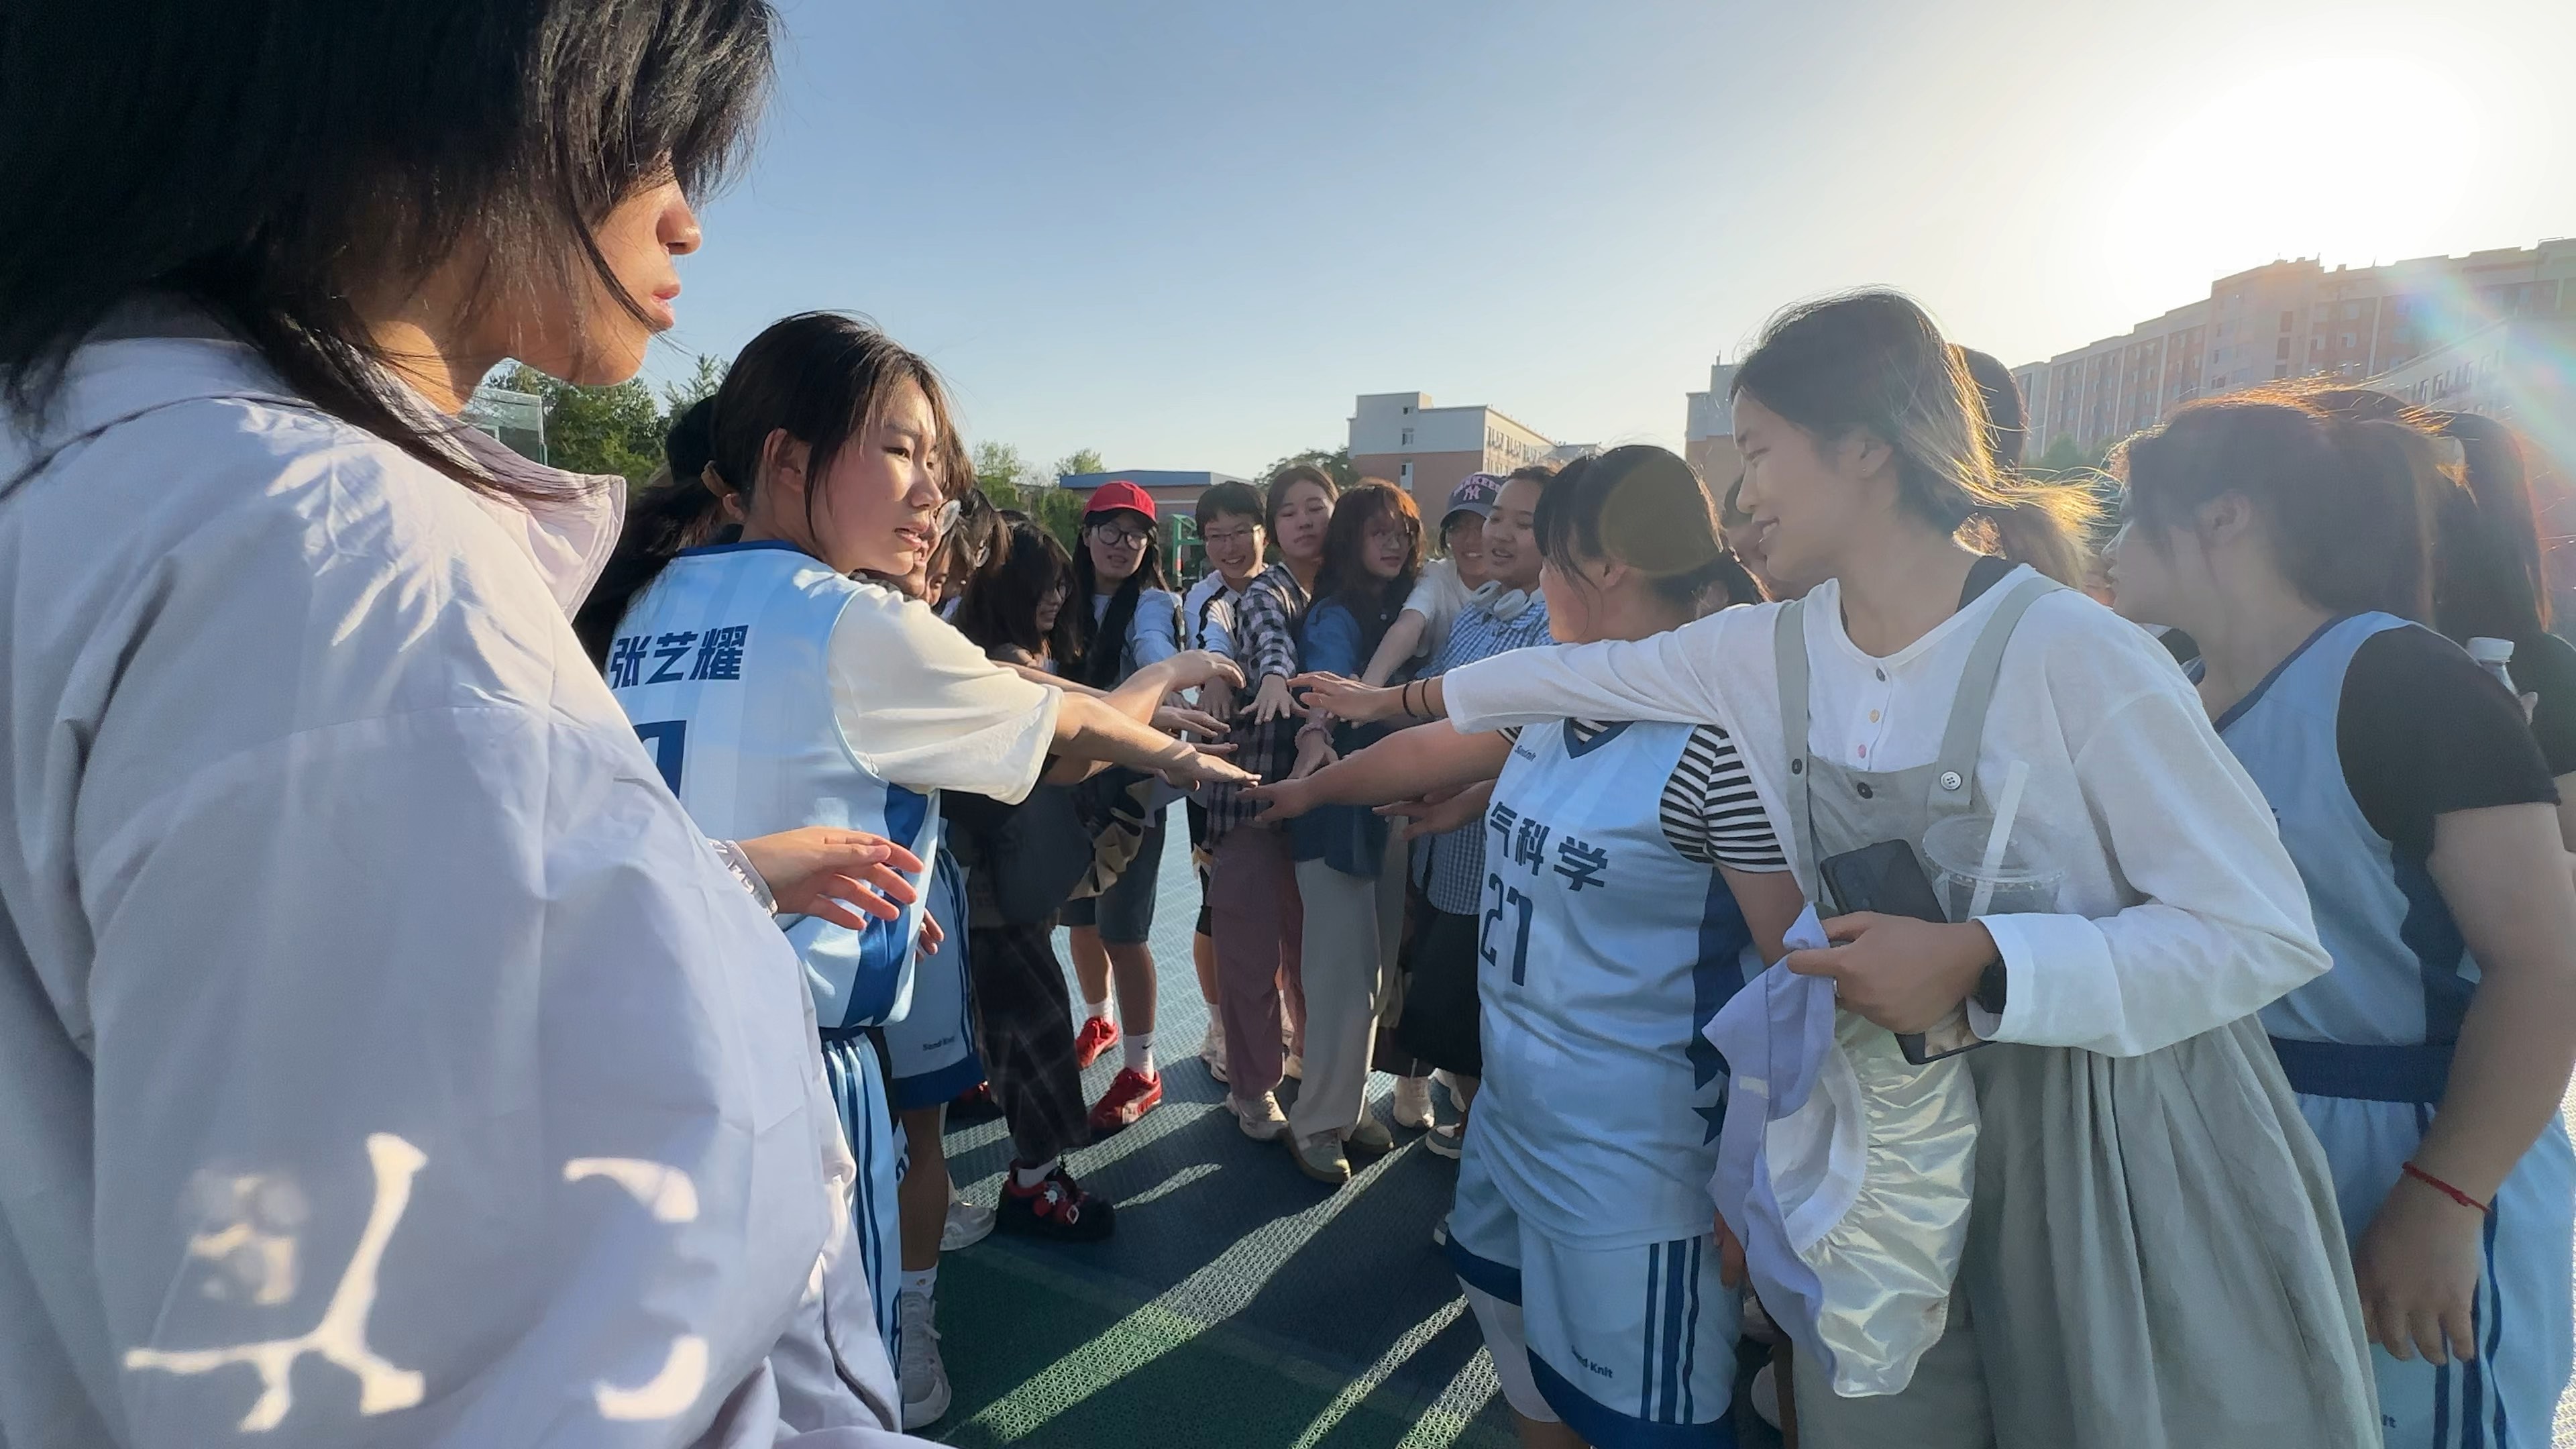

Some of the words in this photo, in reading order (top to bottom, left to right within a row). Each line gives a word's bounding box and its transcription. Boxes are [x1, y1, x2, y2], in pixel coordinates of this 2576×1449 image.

[611, 625, 749, 690] 张艺耀
[1489, 801, 1609, 892] 气科学
[1480, 873, 1534, 987] 27
[1590, 1361, 1613, 1379] Knit
